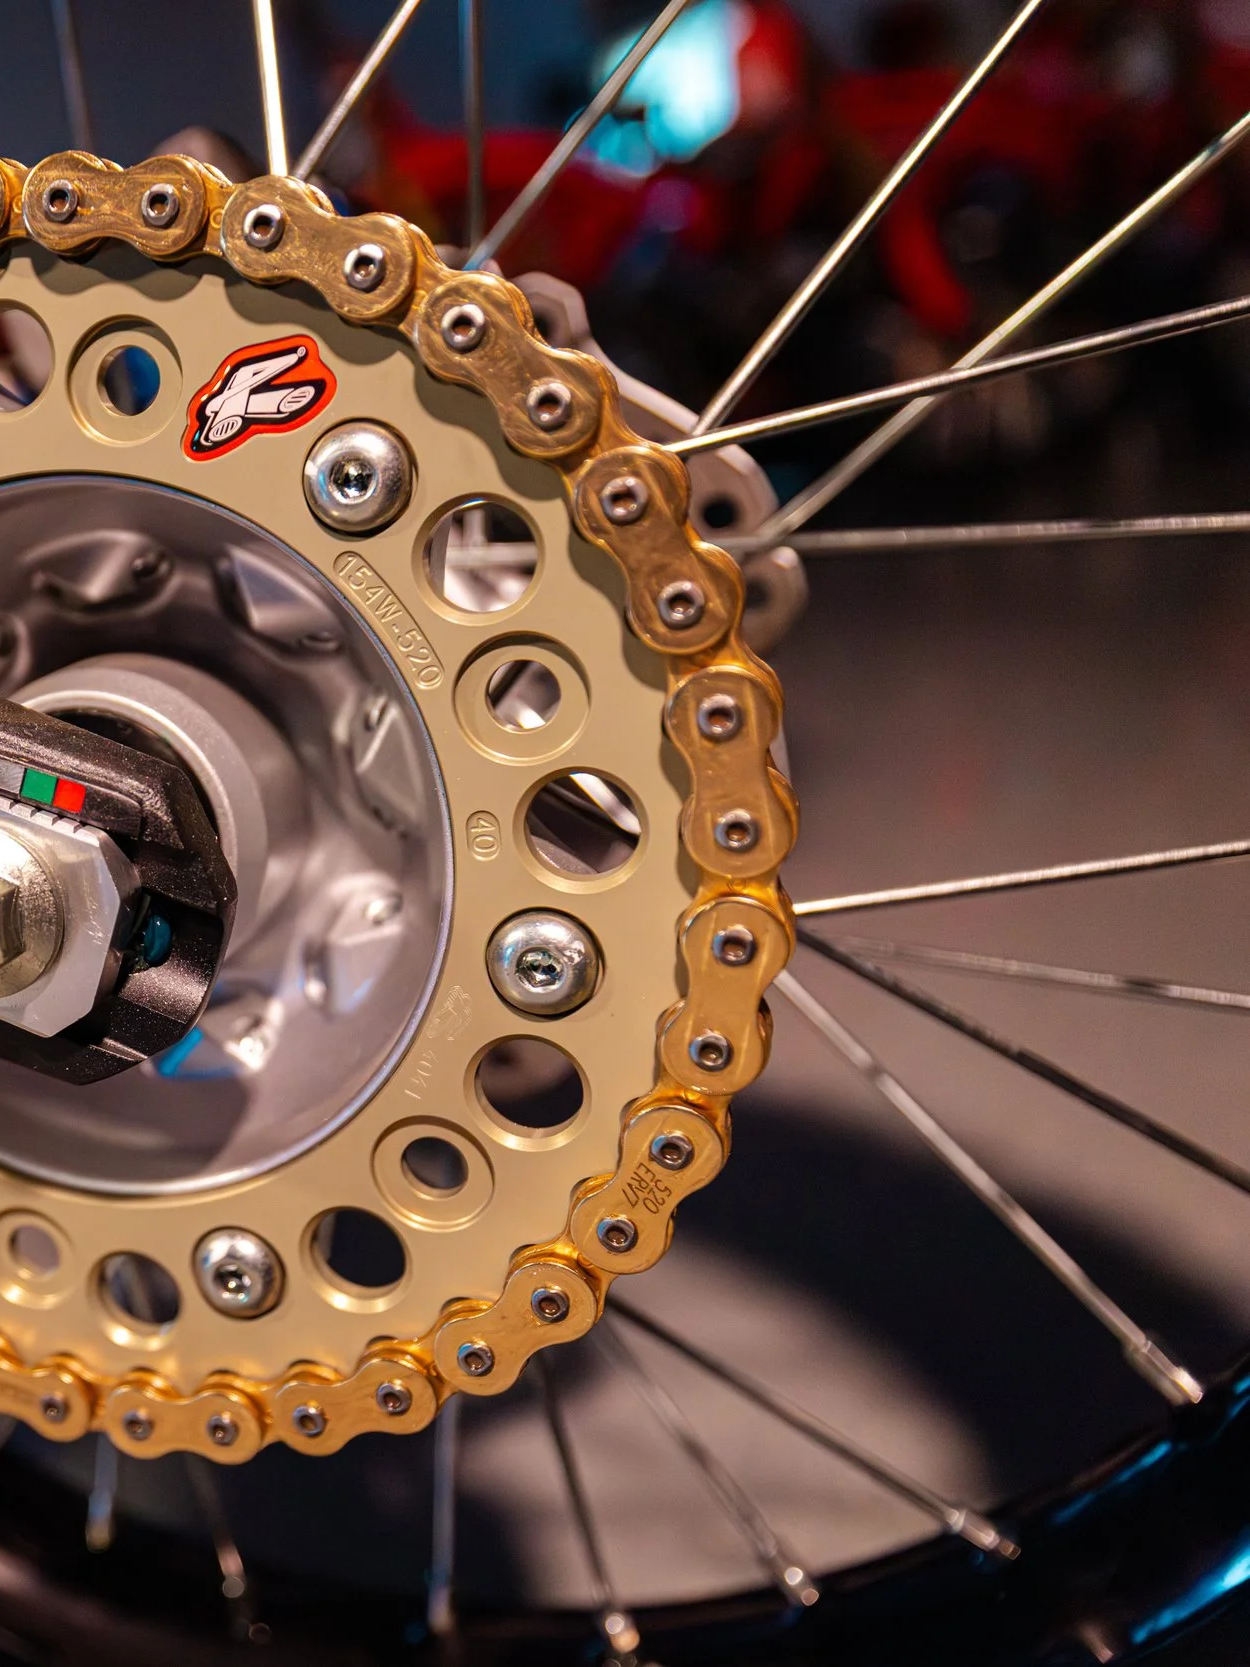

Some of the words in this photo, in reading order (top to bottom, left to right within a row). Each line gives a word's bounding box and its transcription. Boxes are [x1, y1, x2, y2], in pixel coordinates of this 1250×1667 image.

[338, 554, 442, 690] 154W-520
[470, 816, 499, 853] 40
[621, 1162, 656, 1209] ERV7
[643, 1179, 672, 1215] 520
